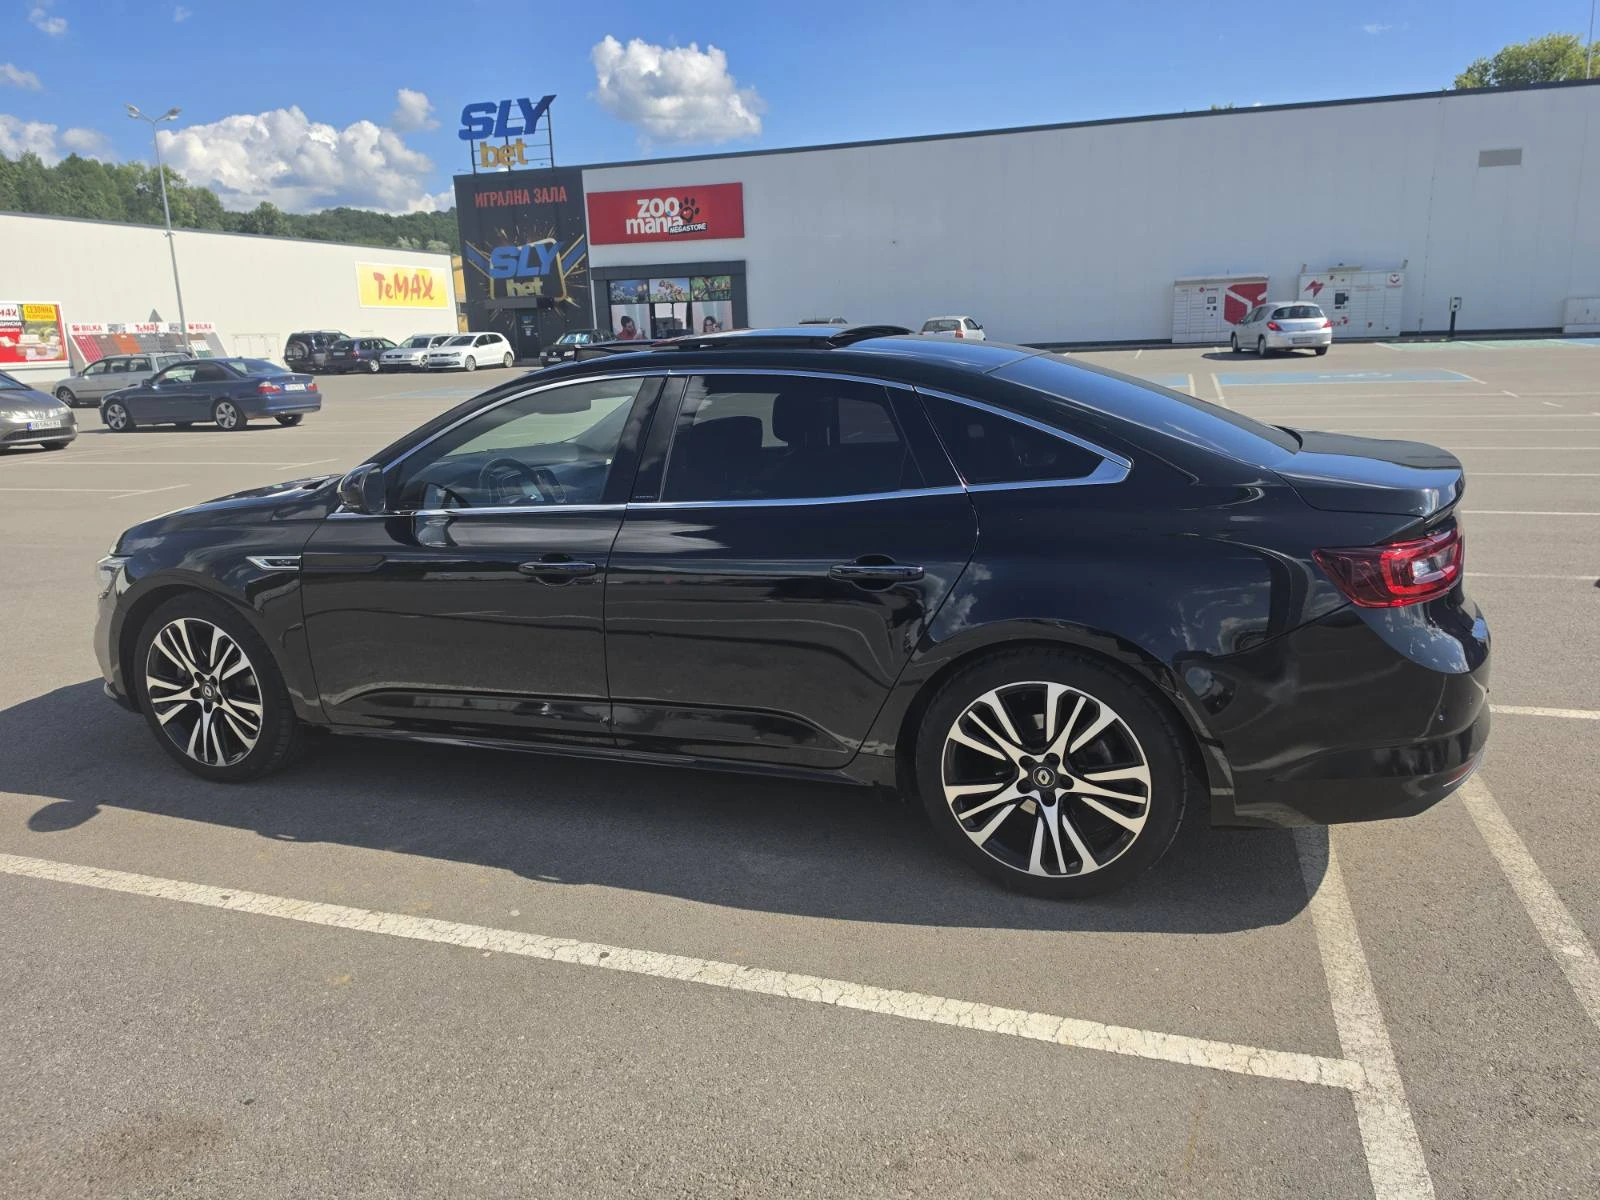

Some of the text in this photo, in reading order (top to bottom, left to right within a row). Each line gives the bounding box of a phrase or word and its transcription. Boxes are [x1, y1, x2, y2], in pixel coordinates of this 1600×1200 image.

[458, 94, 557, 141] SLY
[479, 138, 528, 168] bet
[475, 185, 568, 208] ИГРАЛНА ЗАЛА
[626, 215, 684, 235] mania
[669, 222, 707, 234] MEGASTORE
[489, 240, 564, 279] SLY
[373, 271, 435, 301] TeMAX
[82, 324, 103, 332] BILKA
